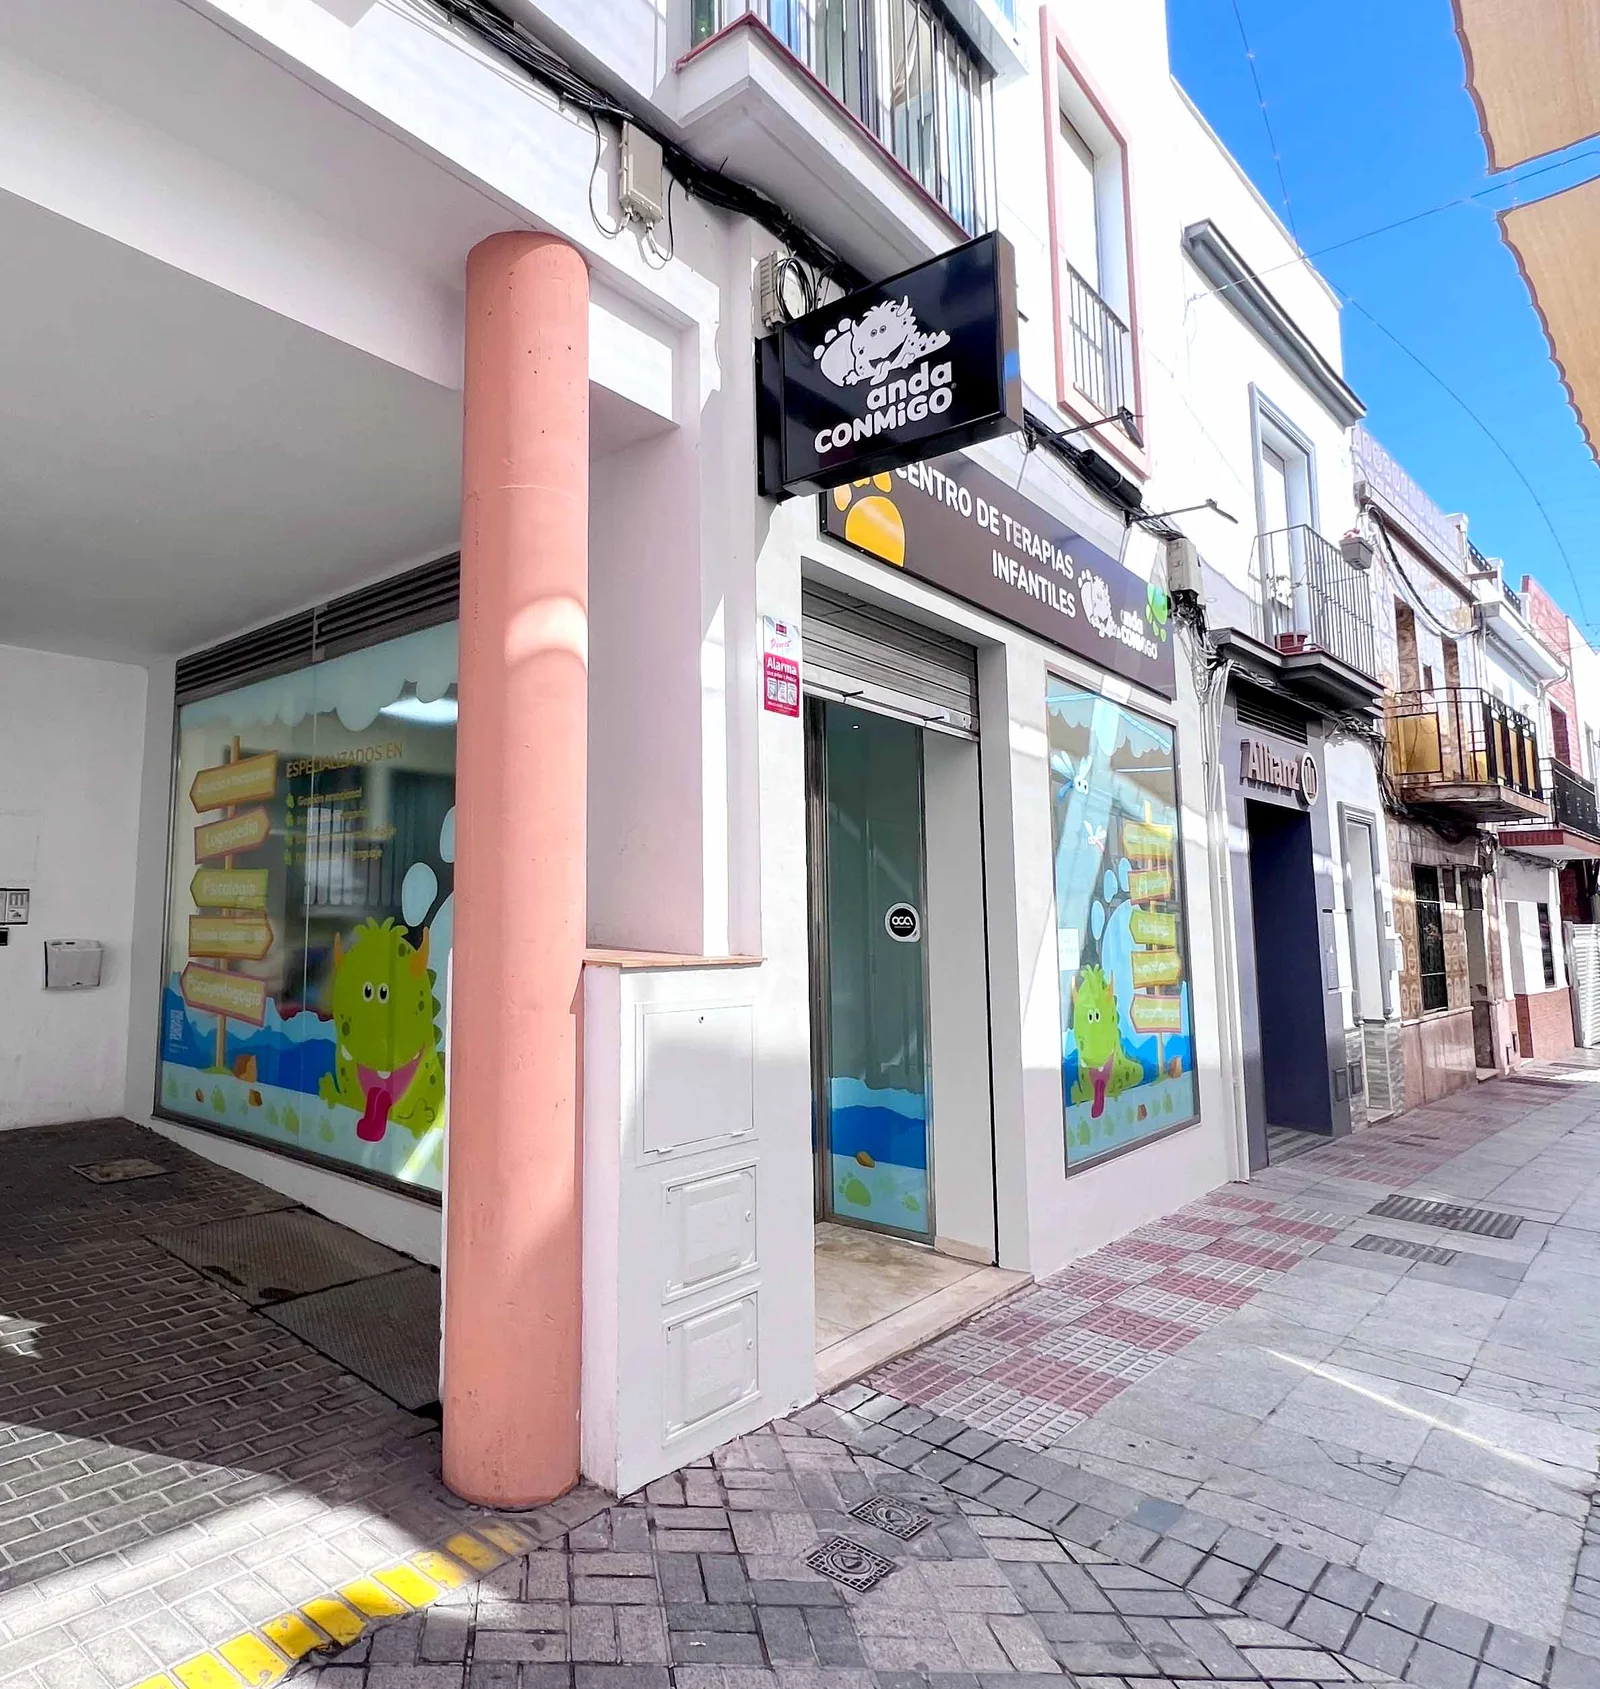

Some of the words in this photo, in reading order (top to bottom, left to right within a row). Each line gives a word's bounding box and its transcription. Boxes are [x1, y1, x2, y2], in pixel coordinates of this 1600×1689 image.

[866, 360, 952, 410] anda
[813, 388, 953, 454] CONMiGO
[976, 498, 1000, 535] DE
[1001, 513, 1075, 579] TERAPIAS
[992, 550, 1077, 618] INFANTILES
[767, 656, 797, 675] Alarma
[286, 744, 383, 779] ESPECIALIZADOS
[386, 742, 404, 760] EN
[1244, 739, 1301, 791] Allianz
[892, 916, 914, 926] oca
